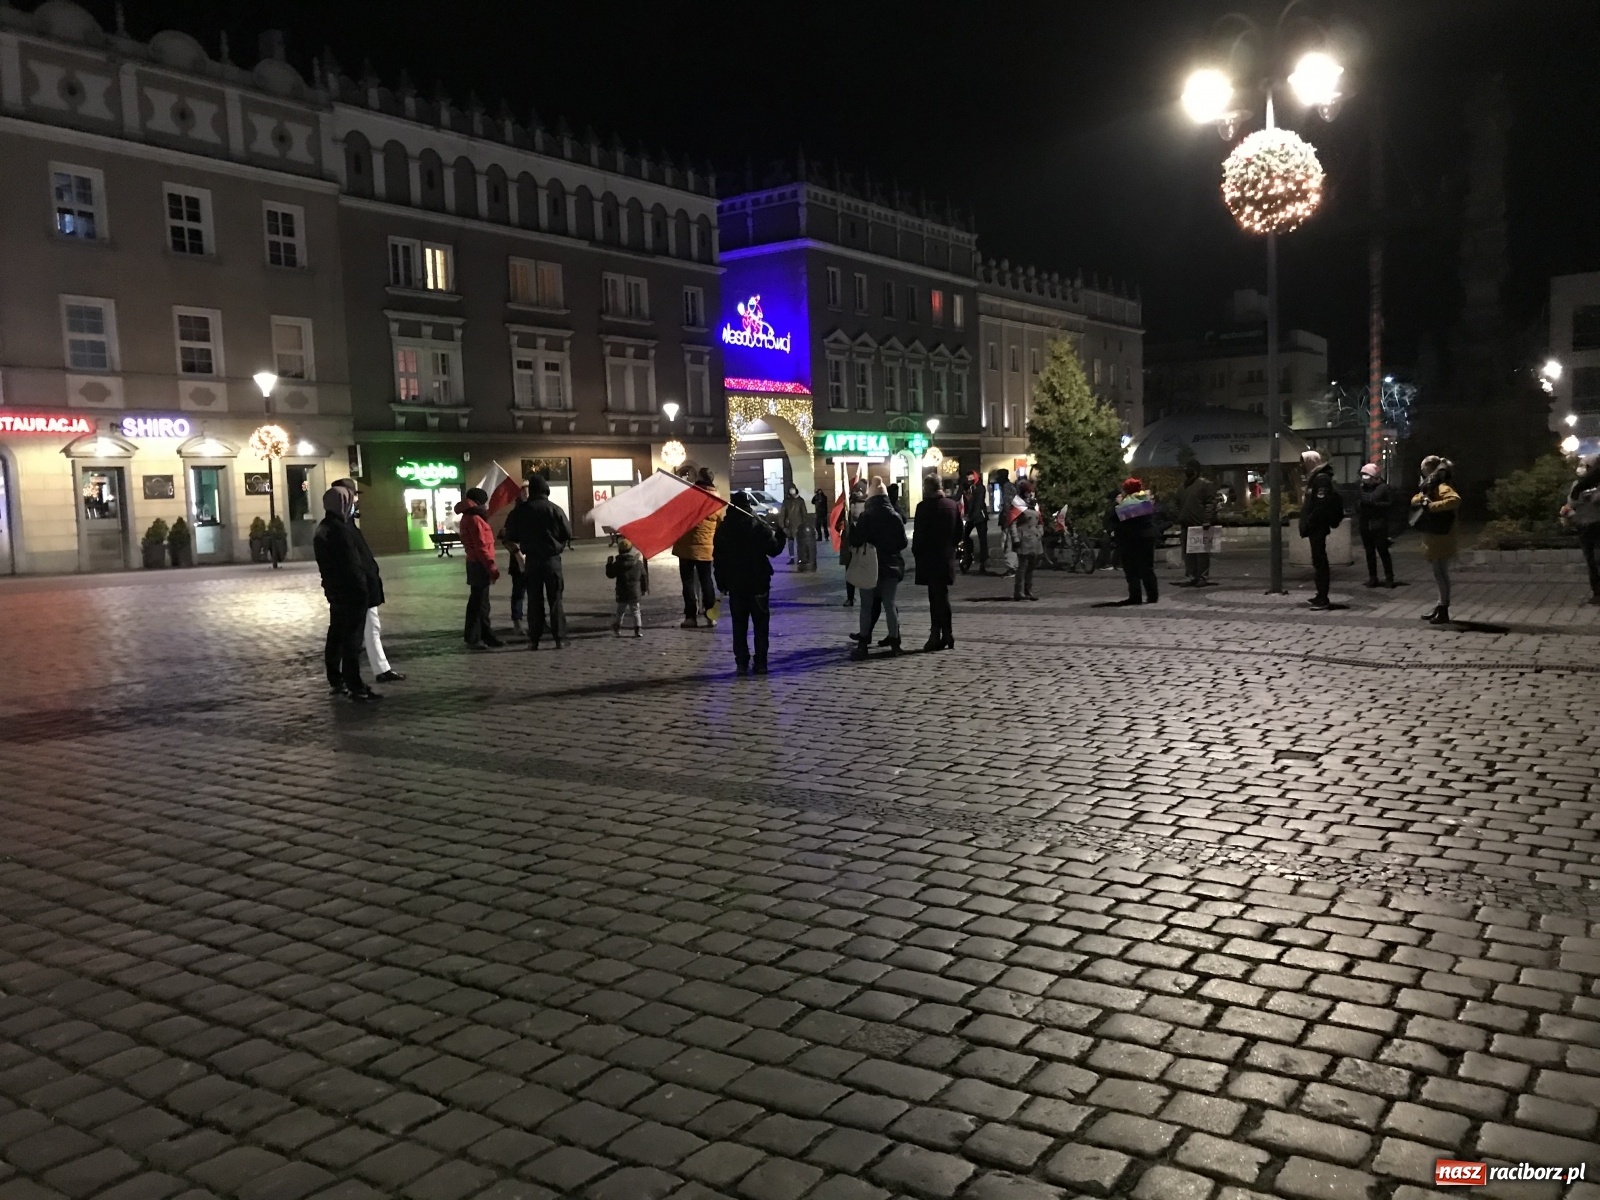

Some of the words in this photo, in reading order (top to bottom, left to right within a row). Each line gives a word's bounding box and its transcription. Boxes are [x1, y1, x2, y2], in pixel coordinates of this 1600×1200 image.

[122, 417, 190, 437] SHIRO
[824, 433, 889, 451] APTEKA
[594, 489, 608, 502] 64
